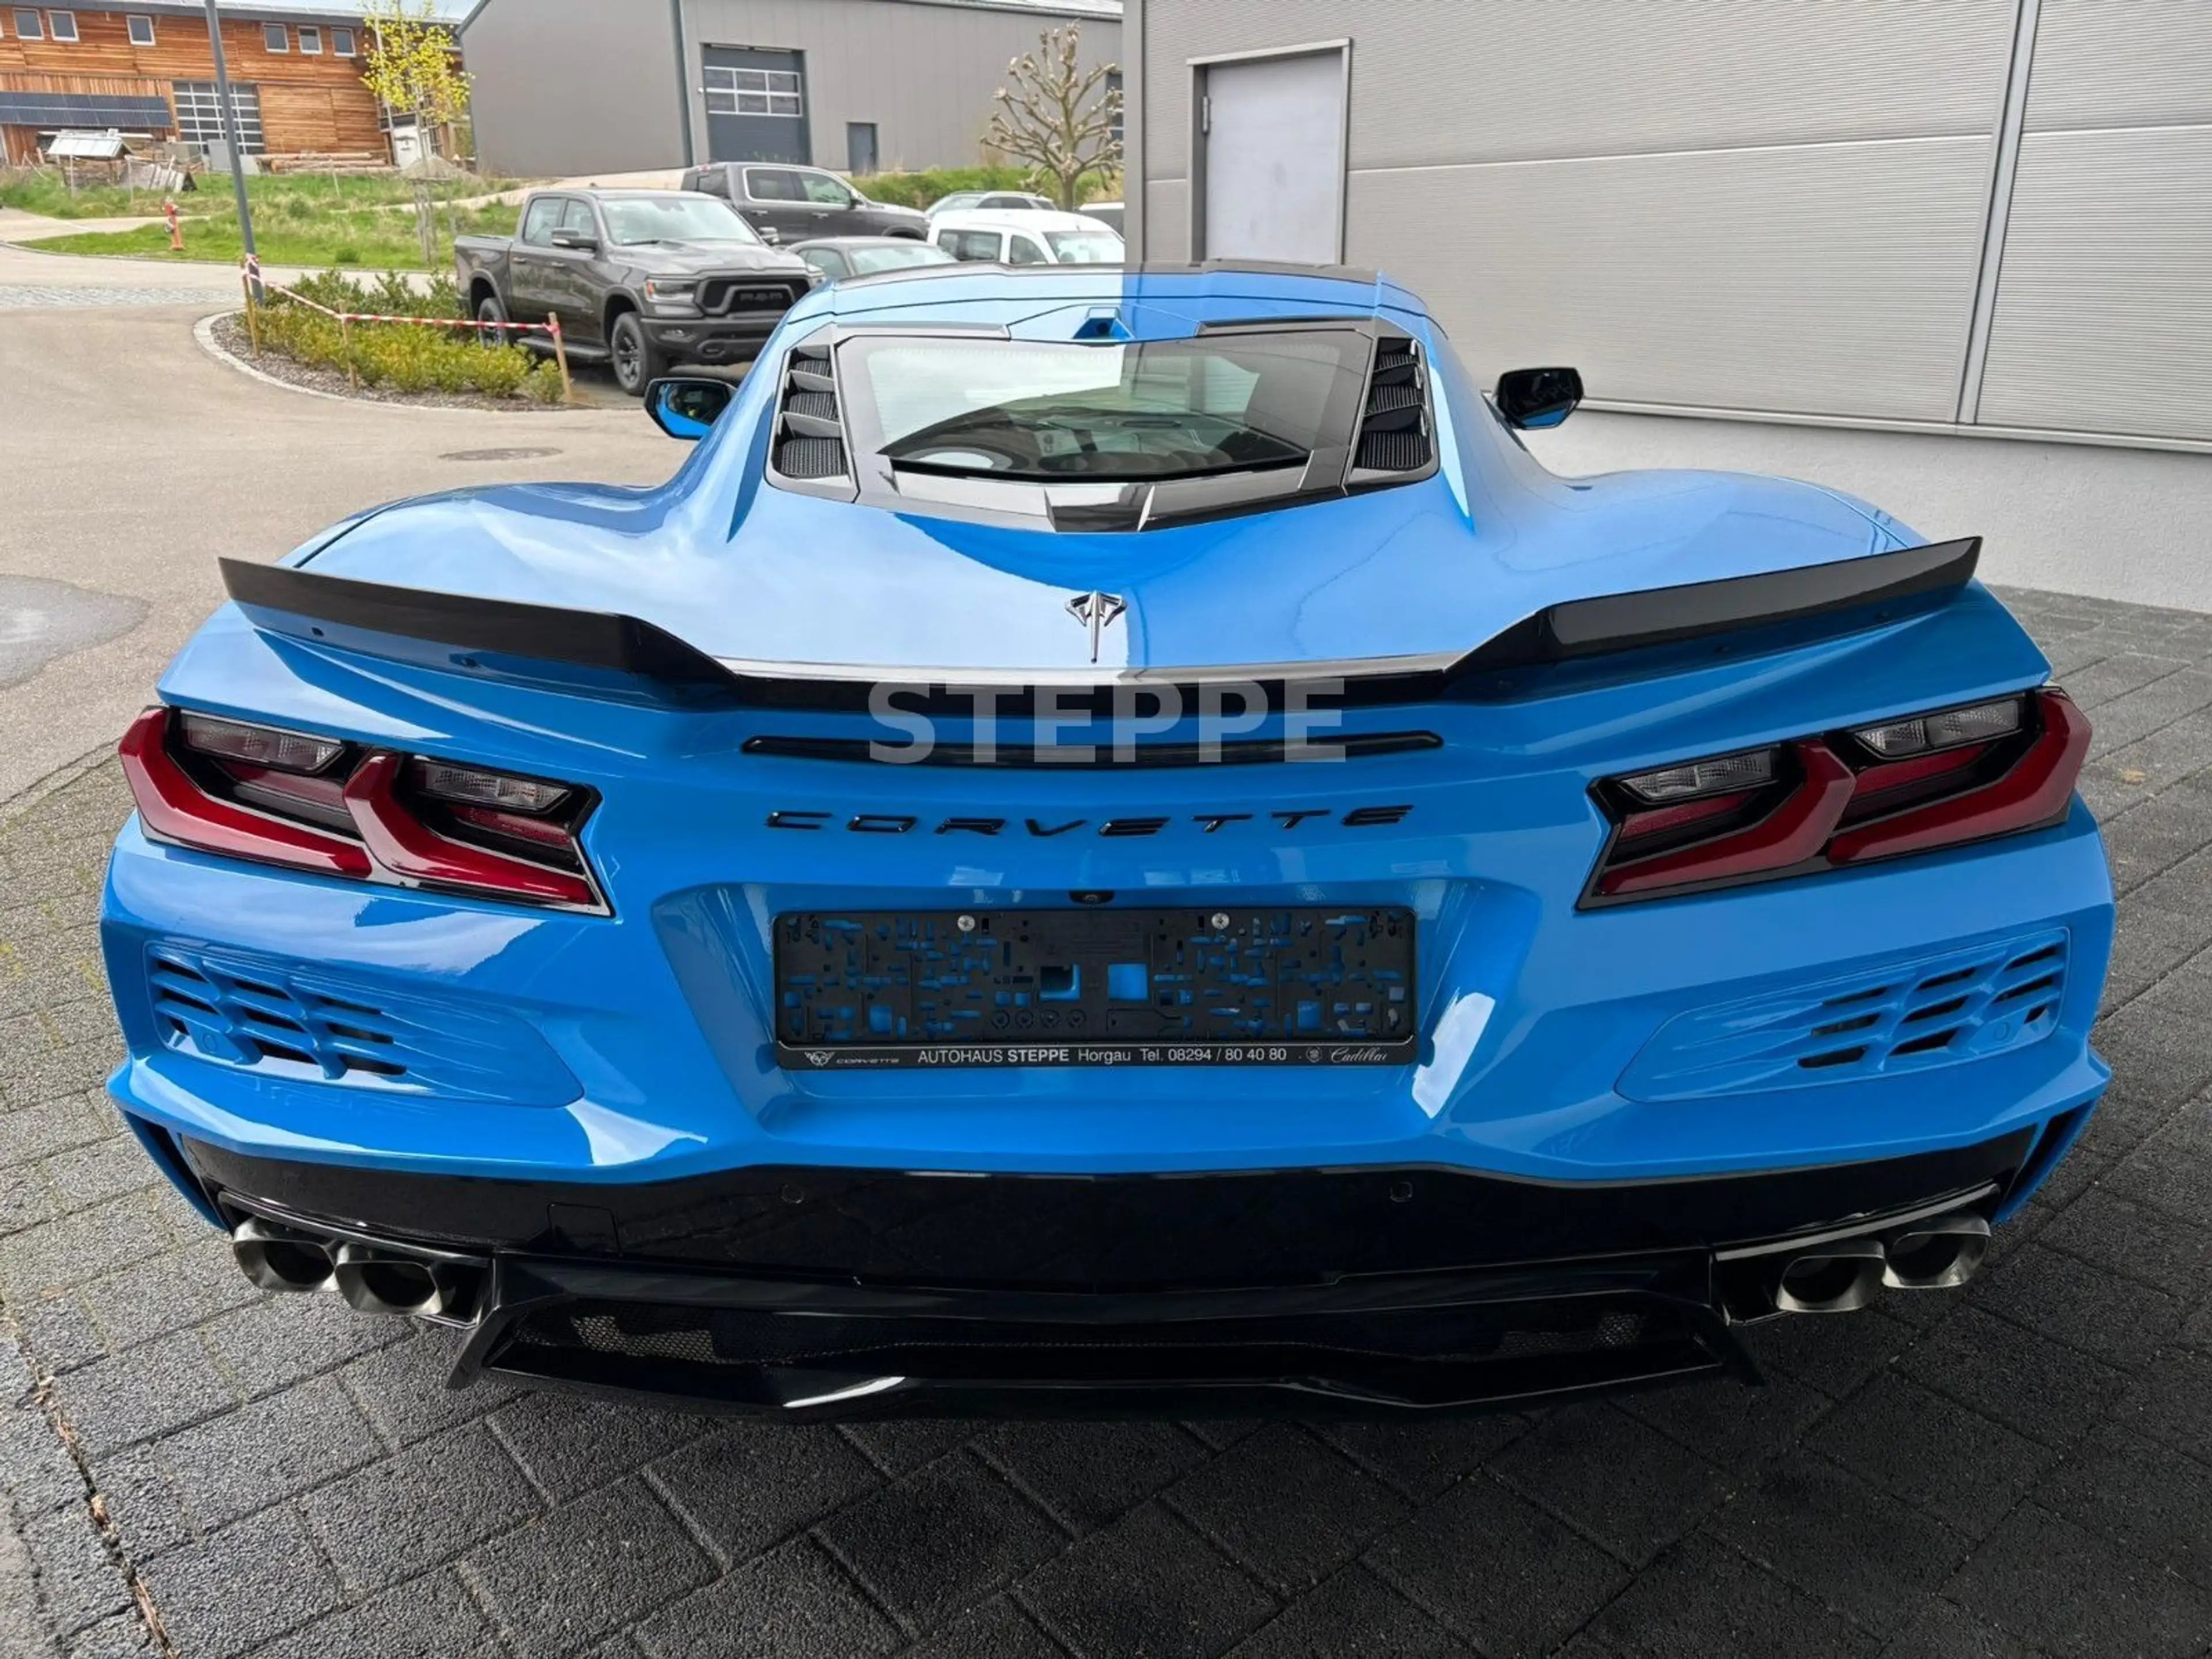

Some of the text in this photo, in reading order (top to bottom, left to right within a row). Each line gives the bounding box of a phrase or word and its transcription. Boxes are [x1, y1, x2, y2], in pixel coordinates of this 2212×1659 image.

[767, 804, 1414, 837] CORVETTE
[918, 1049, 1003, 1064] AUTOHAUS
[1007, 1048, 1070, 1062] STEPPE
[1078, 1048, 1131, 1064] Horgau
[1139, 1048, 1164, 1062] Tel.
[1168, 1048, 1211, 1062] 08294
[1225, 1047, 1243, 1061] 80
[1247, 1047, 1265, 1061] 40
[1268, 1047, 1287, 1060] 80
